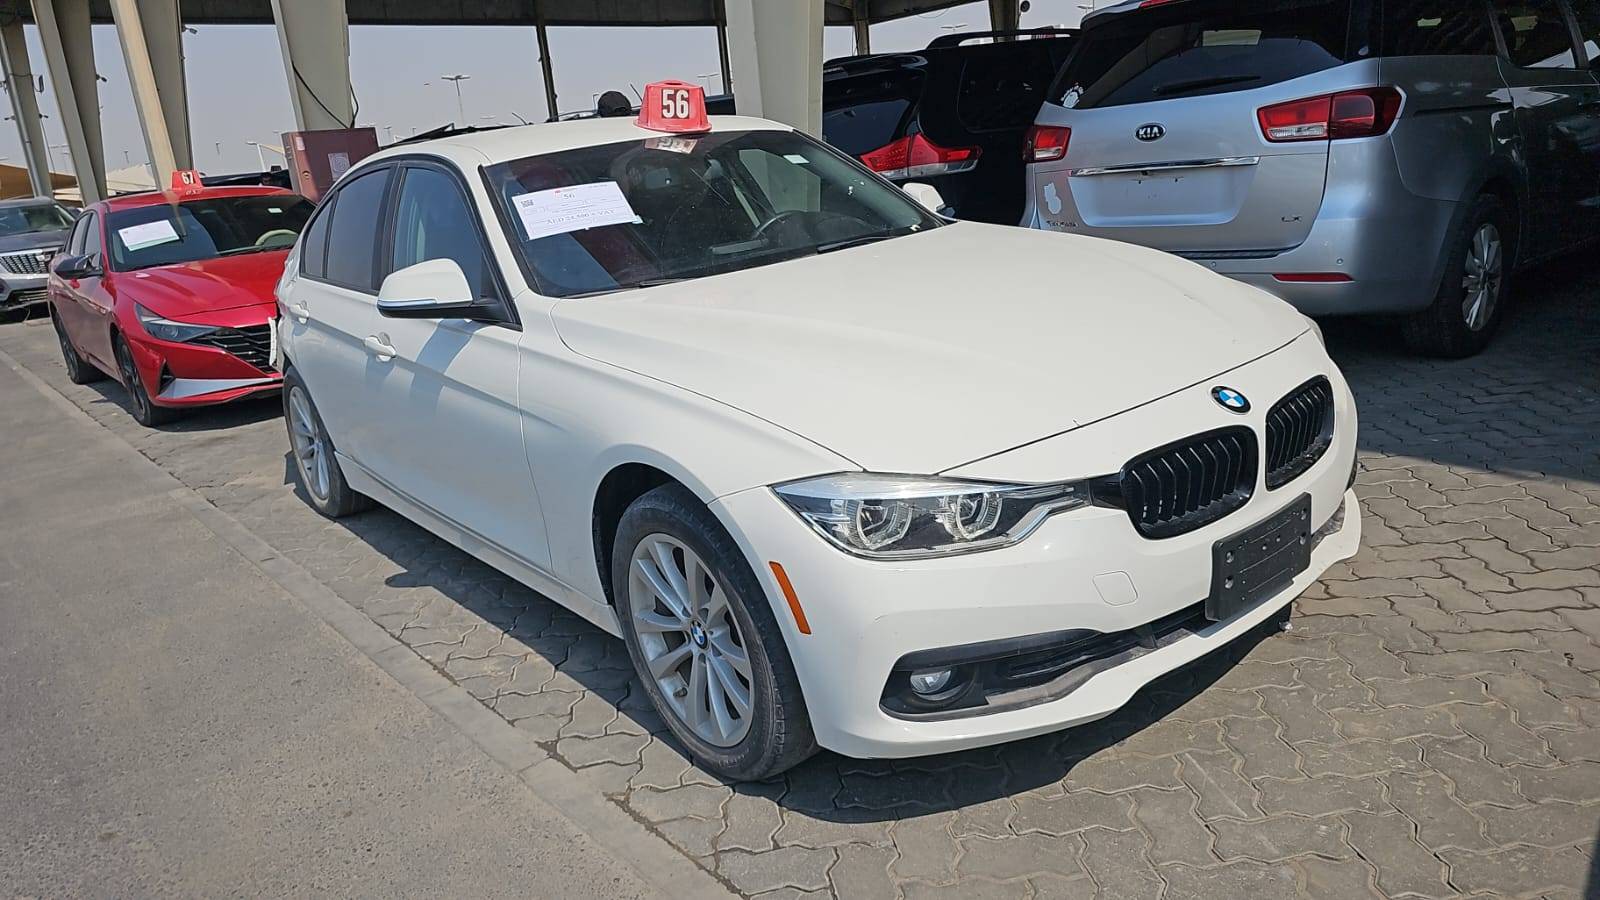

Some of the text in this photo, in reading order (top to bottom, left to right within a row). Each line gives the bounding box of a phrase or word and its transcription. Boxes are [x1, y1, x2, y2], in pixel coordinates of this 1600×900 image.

[662, 89, 689, 118] 56
[1139, 126, 1160, 138] KIA
[181, 172, 194, 184] 67
